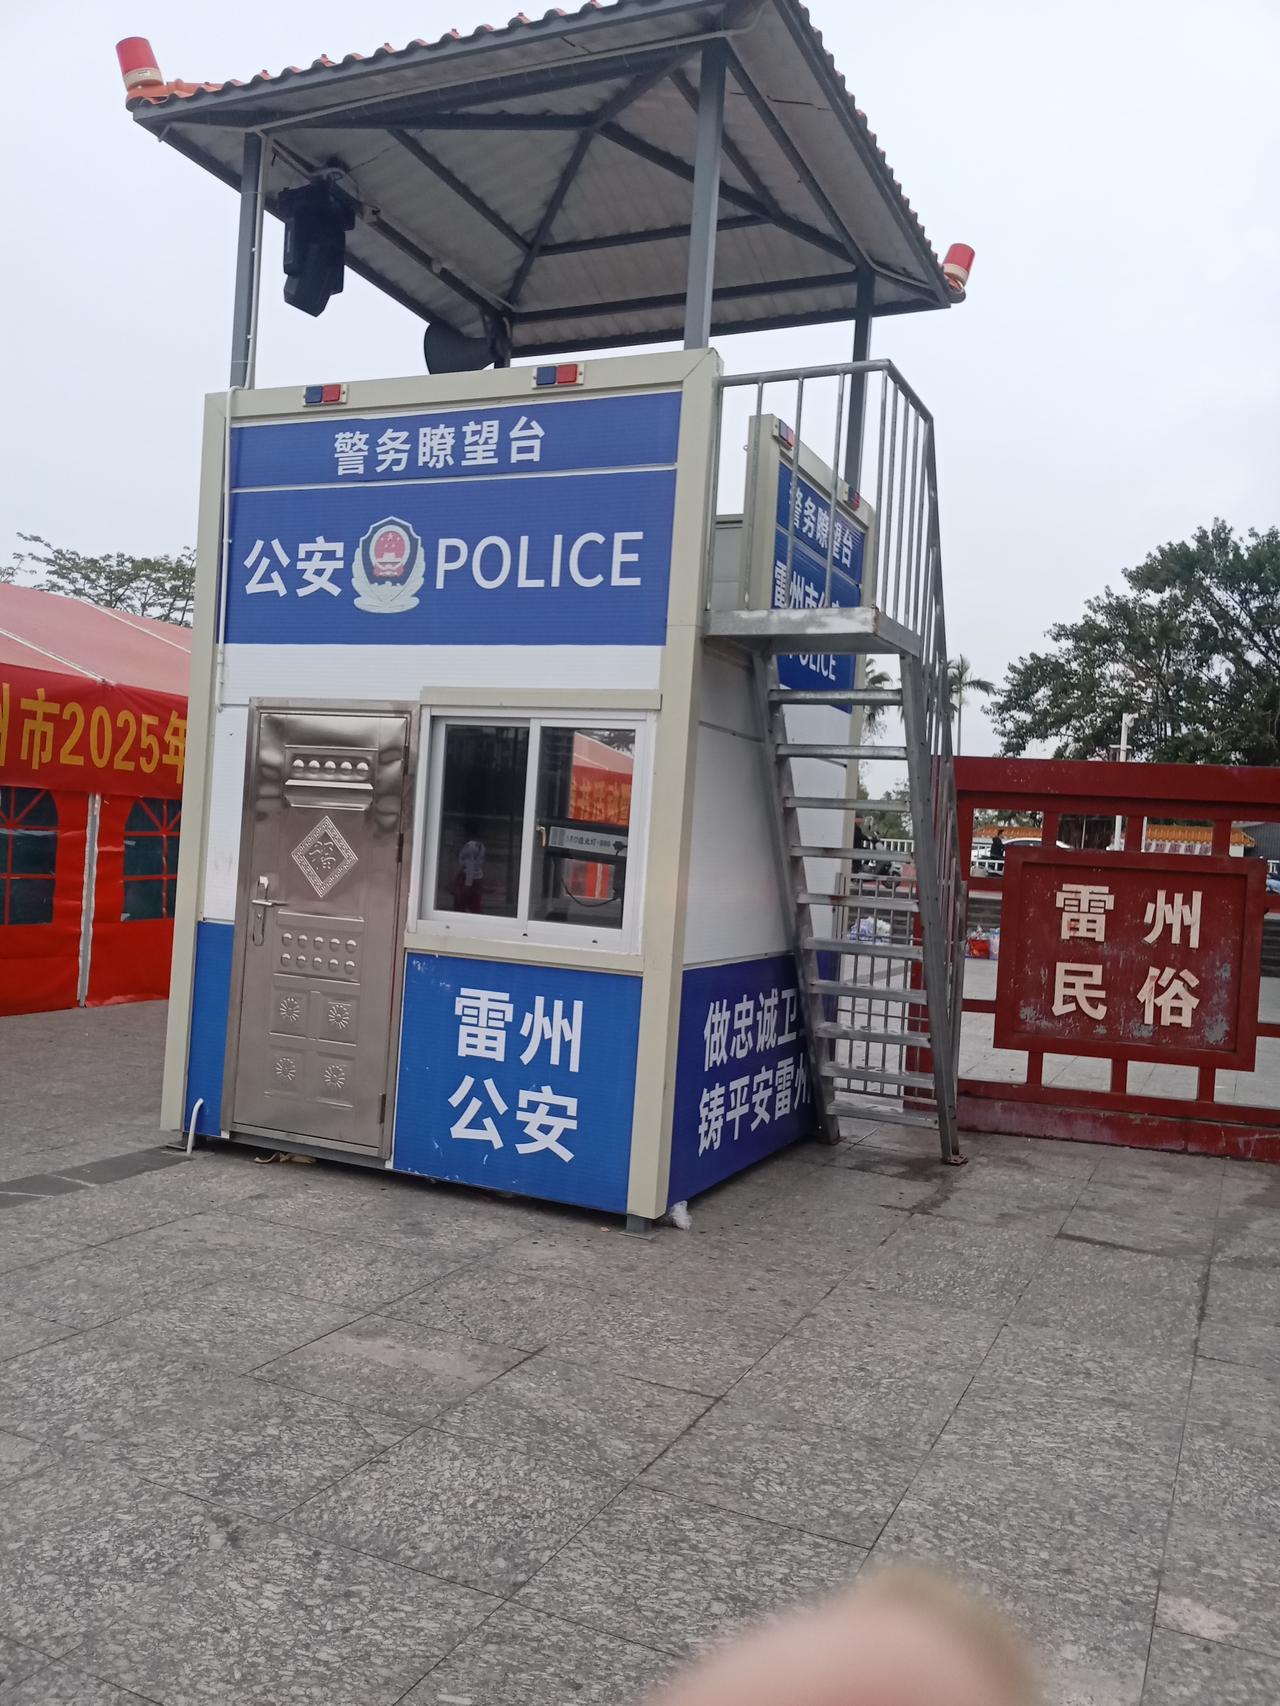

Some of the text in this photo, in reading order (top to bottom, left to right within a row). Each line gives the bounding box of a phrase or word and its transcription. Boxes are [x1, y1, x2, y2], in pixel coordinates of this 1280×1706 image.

[334, 416, 545, 476] 警务瞭望台
[243, 536, 345, 597] 公安
[435, 531, 644, 589] POLICE
[1056, 883, 1203, 949] 雷州
[1051, 962, 1201, 1028] 民俗
[454, 987, 584, 1073] 雷州
[704, 987, 806, 1073] 做忠诚卫
[447, 1074, 578, 1163] 公安
